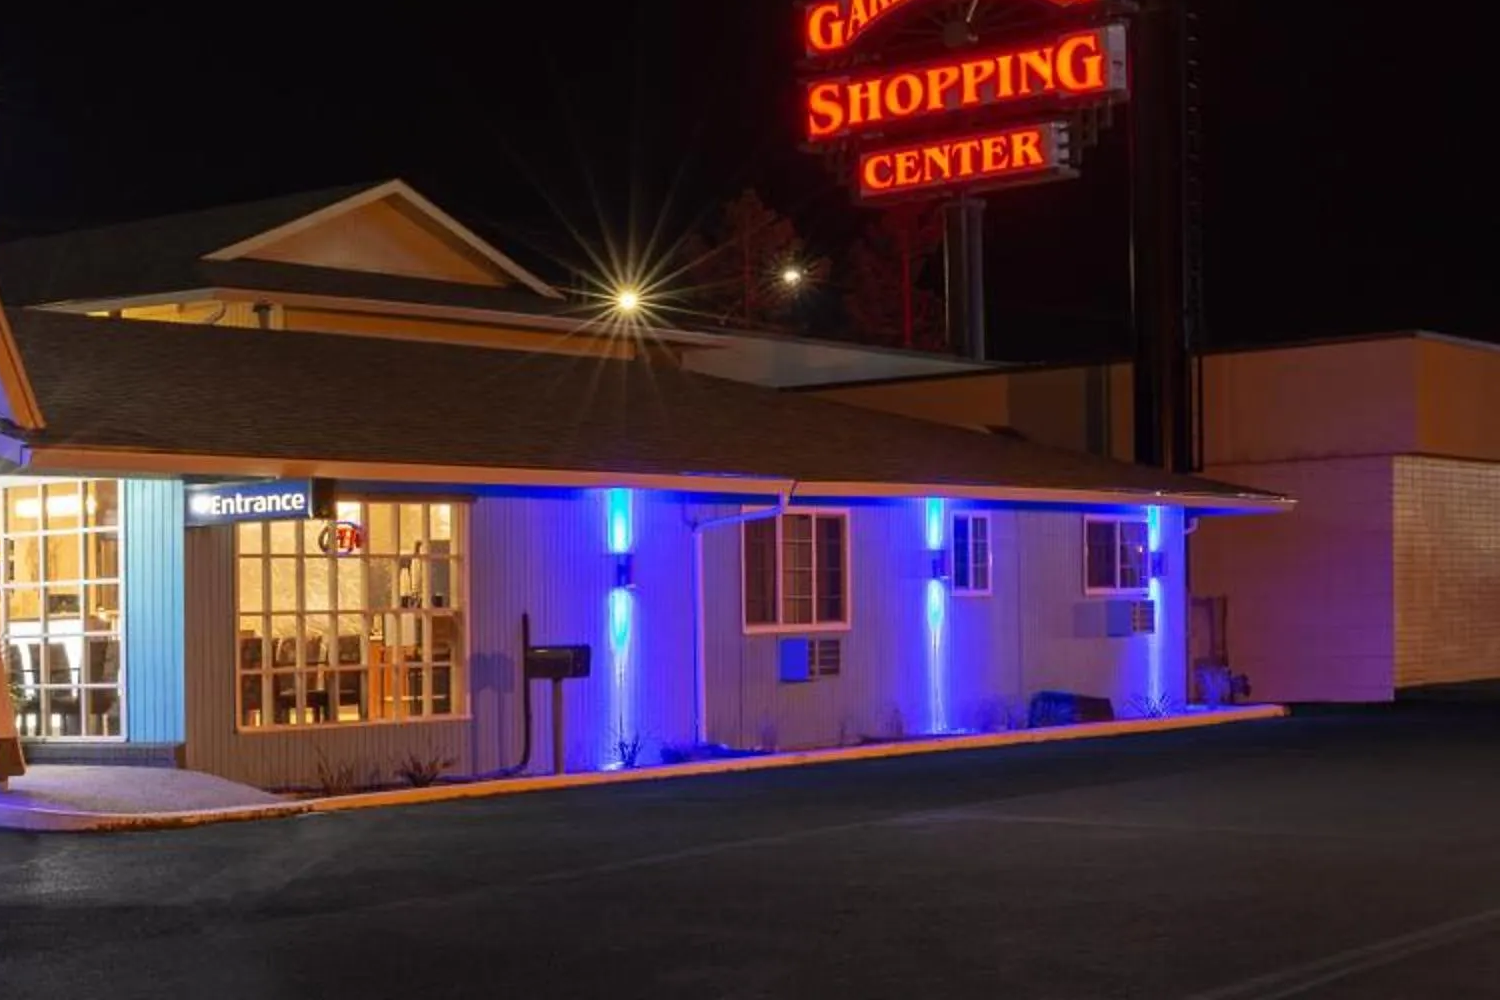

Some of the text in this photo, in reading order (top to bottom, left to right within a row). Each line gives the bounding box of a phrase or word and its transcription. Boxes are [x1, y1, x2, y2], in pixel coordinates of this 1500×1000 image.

[808, 34, 1103, 135] SHOPPING
[863, 129, 1044, 190] CENTER
[211, 492, 305, 515] Entrance
